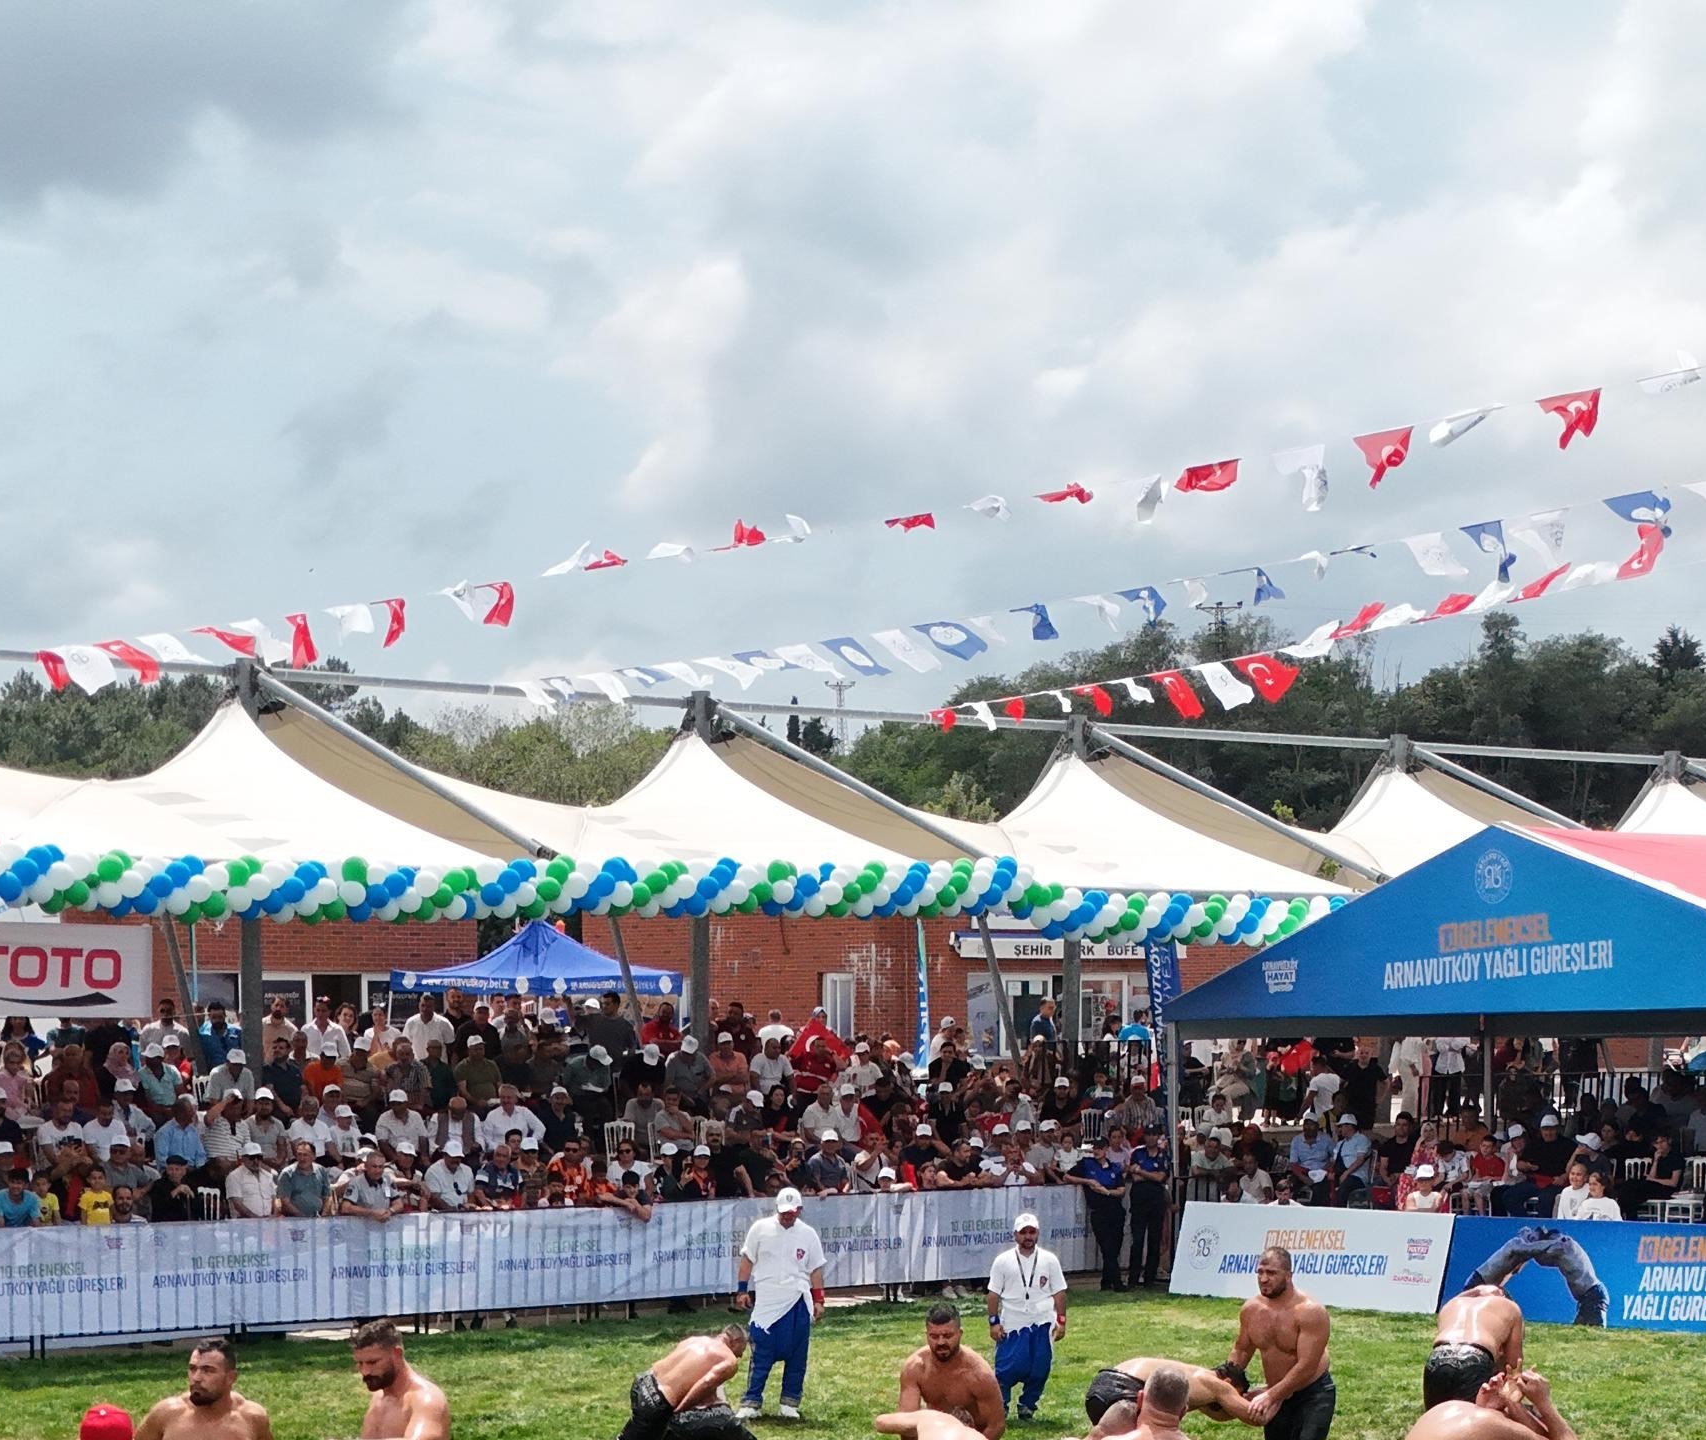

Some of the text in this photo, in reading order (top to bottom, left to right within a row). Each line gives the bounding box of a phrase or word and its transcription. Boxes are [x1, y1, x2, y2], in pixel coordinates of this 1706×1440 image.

[1014, 944, 1052, 957] ŞEHİR
[1383, 939, 1613, 990] ARNAVUTKÖY YAĞLI GÜREŞLERİ
[1267, 971, 1293, 981] HAYAT
[1280, 1230, 1346, 1250] GELENEKSEL
[1218, 1252, 1389, 1277] ARNAV YAĞLI GÜREŞLERİ
[1622, 1293, 1668, 1321] YAĞLI
